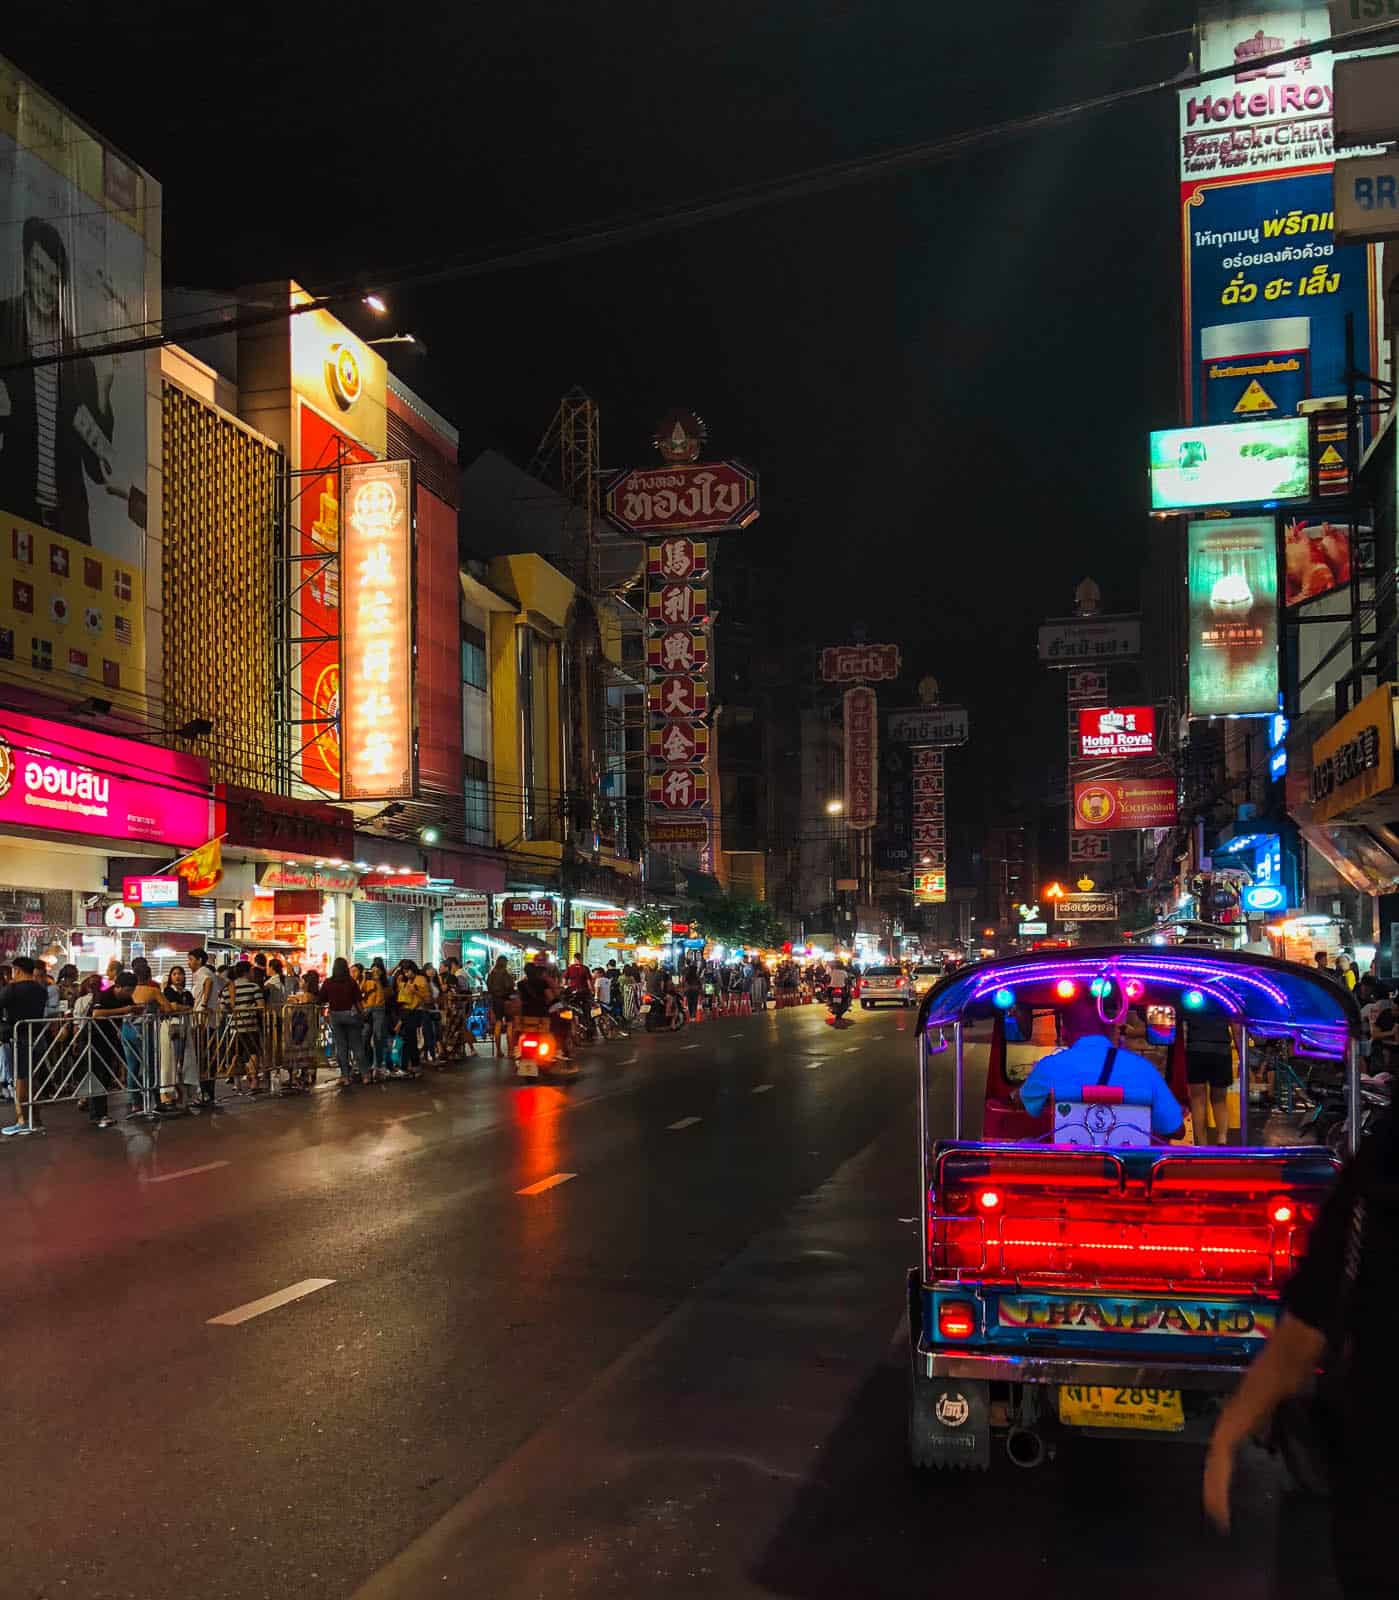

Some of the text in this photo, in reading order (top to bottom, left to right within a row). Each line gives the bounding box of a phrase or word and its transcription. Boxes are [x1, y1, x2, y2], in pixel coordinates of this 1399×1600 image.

[1187, 85, 1275, 126] Hotel
[1184, 127, 1265, 161] Bangkok
[1195, 228, 1260, 247] ให้ทุกเมนู
[1222, 243, 1334, 269] อร่อยลงตัวด้วย
[1221, 265, 1342, 305] ฉั่ว ฮะ เส็ง
[623, 471, 740, 521] ทองใบ
[1082, 734, 1115, 746] Hotel
[1018, 1299, 1256, 1333] THAILAND
